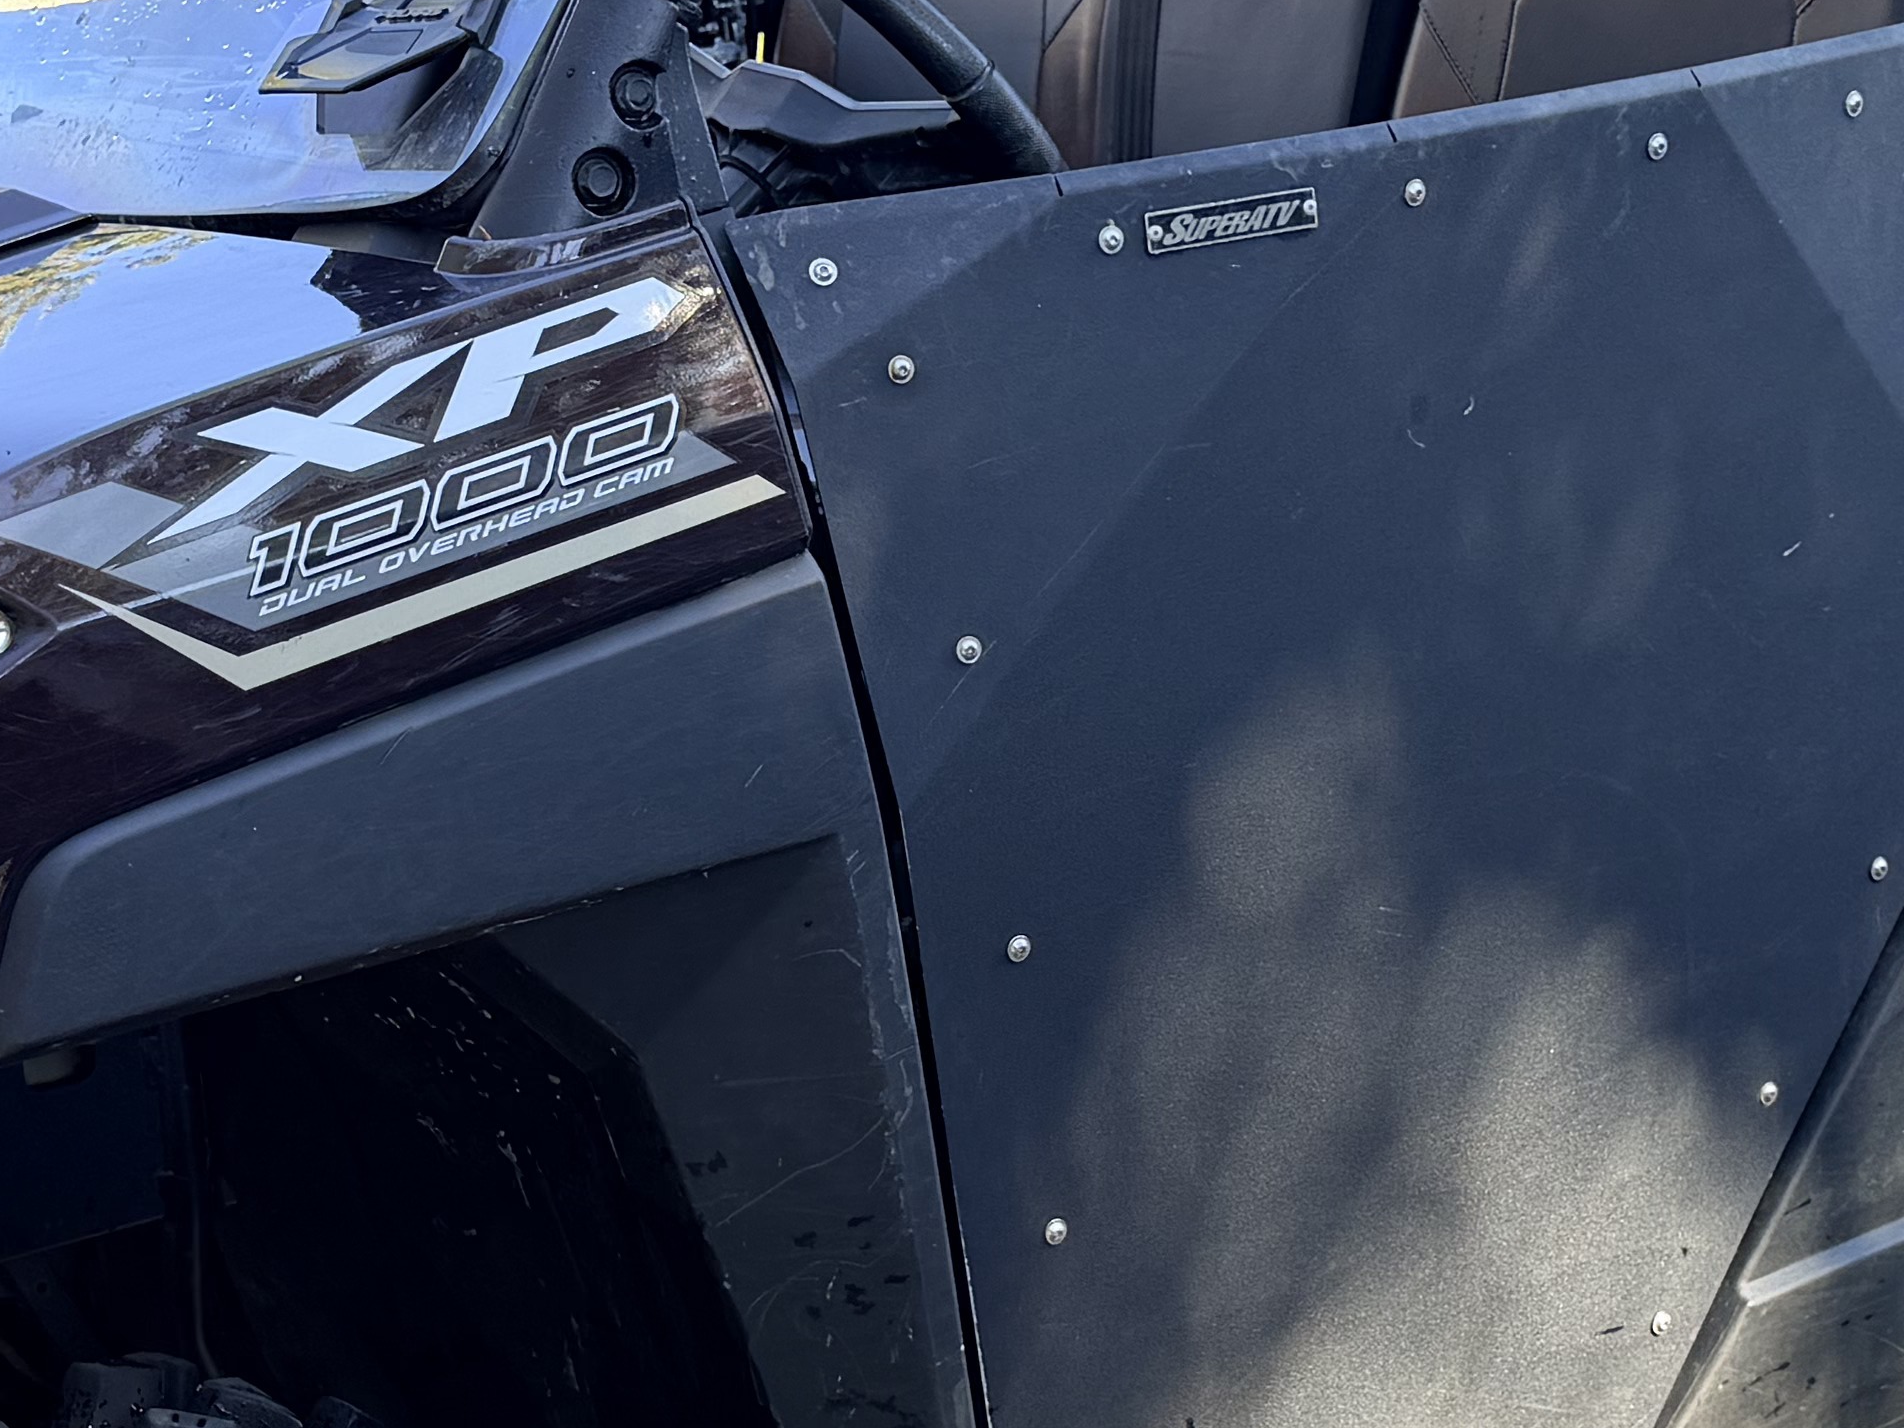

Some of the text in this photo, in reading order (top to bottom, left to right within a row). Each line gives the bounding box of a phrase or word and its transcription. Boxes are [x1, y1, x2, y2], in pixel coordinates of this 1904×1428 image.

[147, 276, 687, 546] XP
[248, 393, 680, 600] 1000
[259, 457, 674, 617] DUAL OVERHEAD CAM
